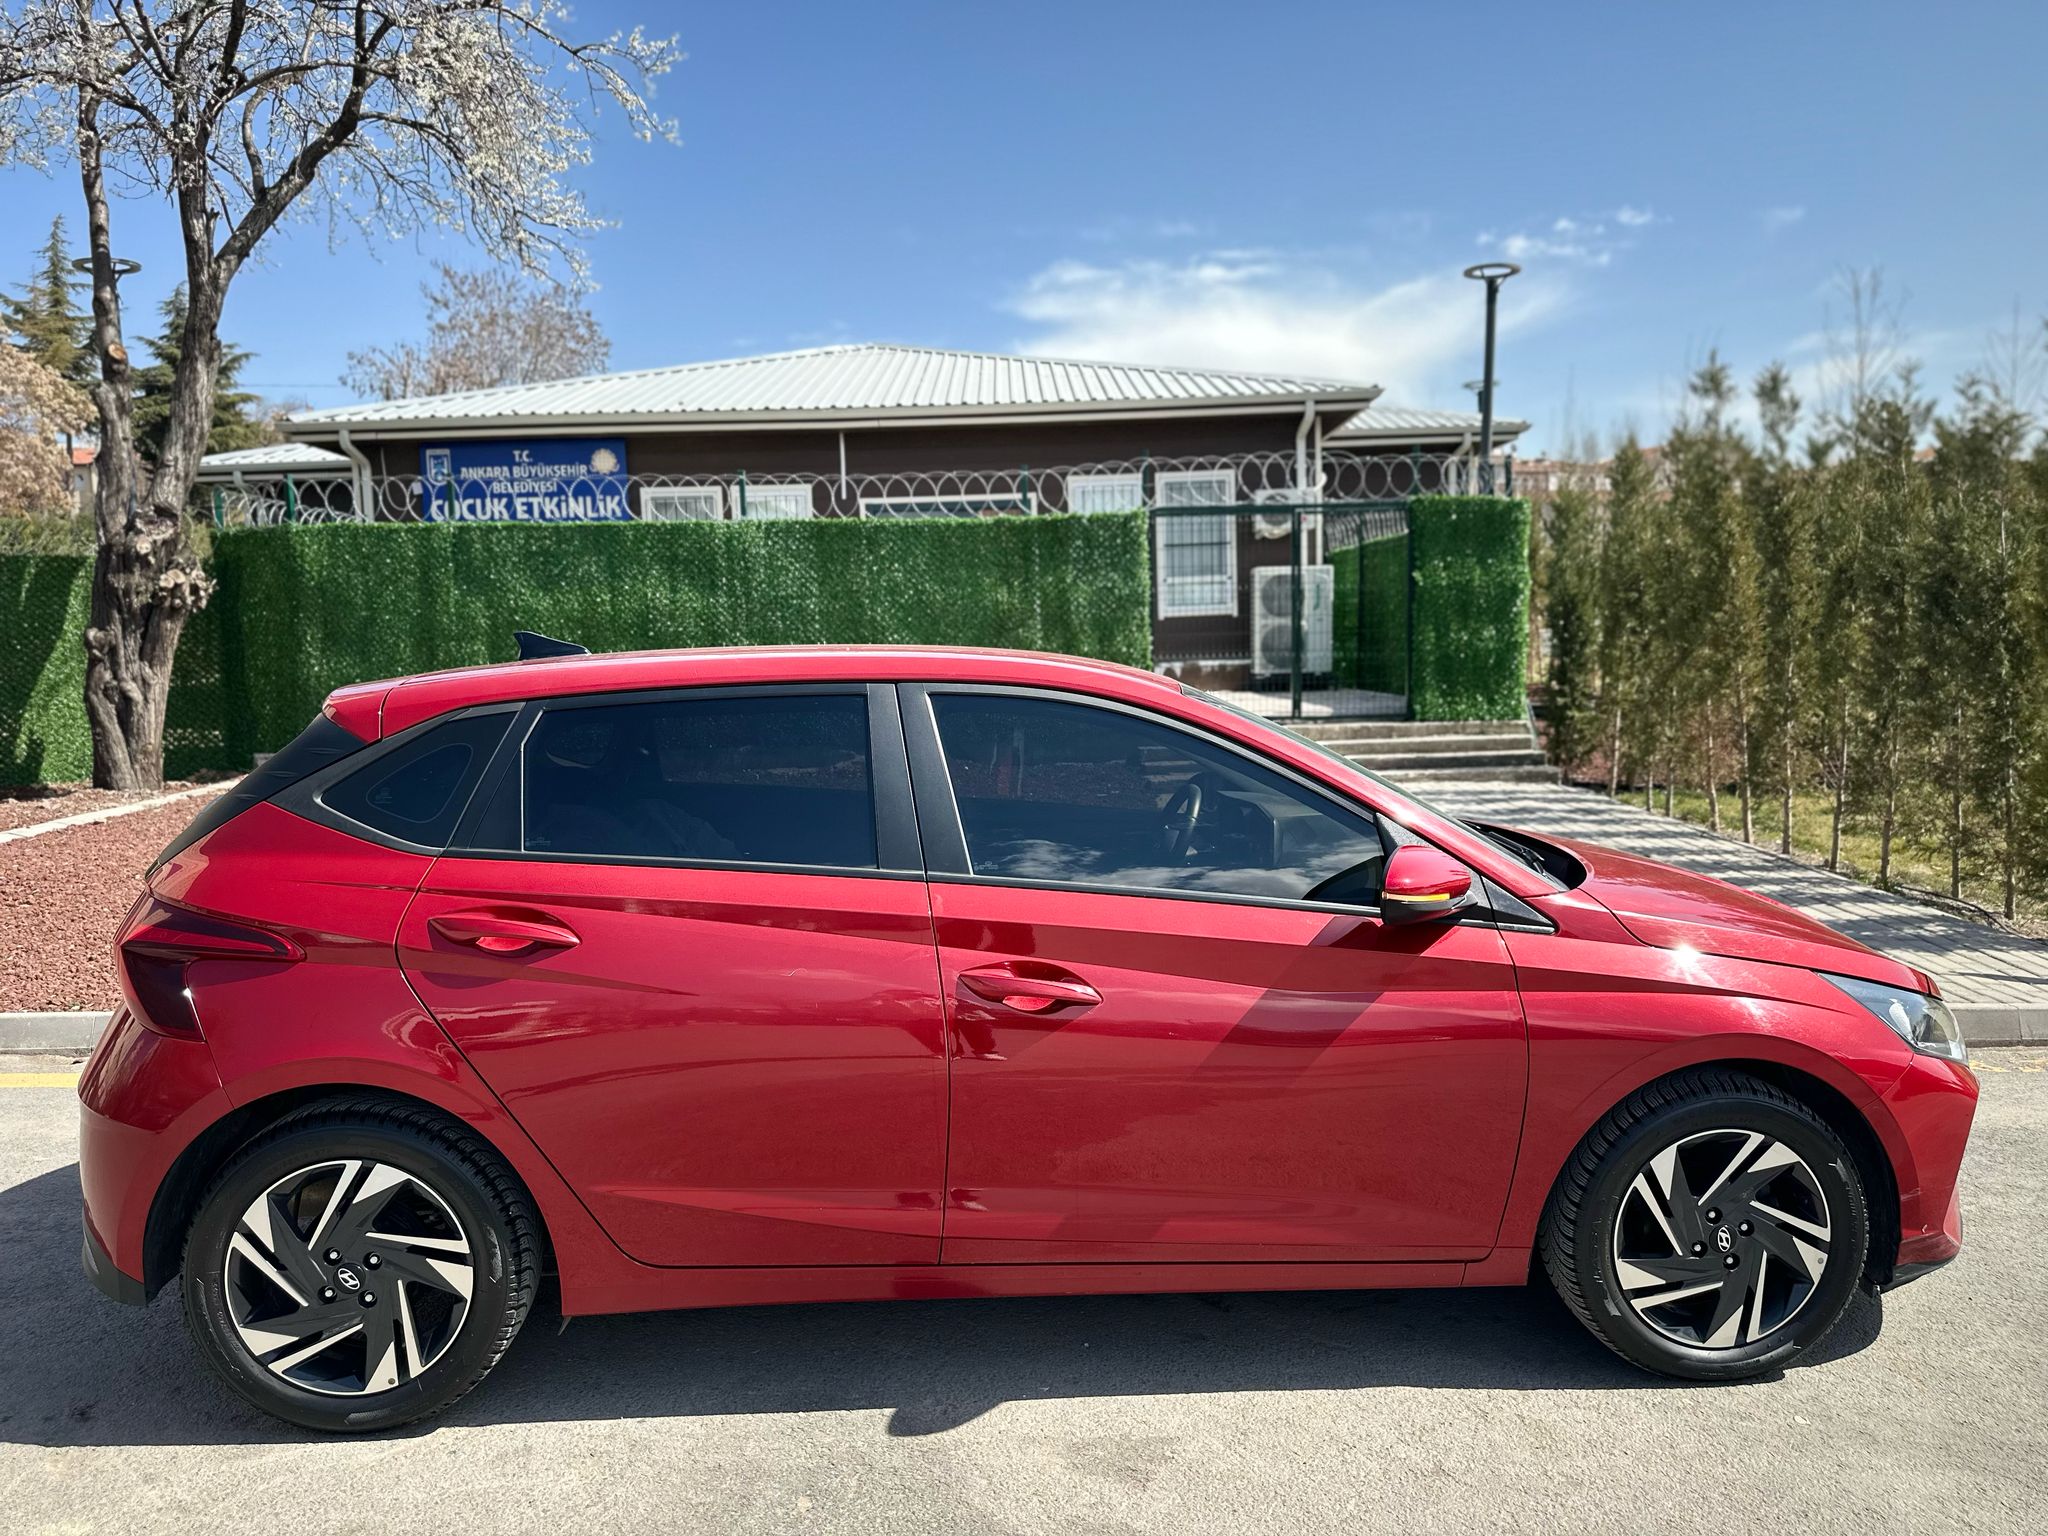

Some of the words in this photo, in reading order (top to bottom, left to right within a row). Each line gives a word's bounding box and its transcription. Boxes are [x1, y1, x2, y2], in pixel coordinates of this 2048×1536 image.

[512, 450, 533, 462] T.C.
[460, 466, 511, 480] ANKARA
[512, 462, 588, 479] BÜYÜKŞEHİR
